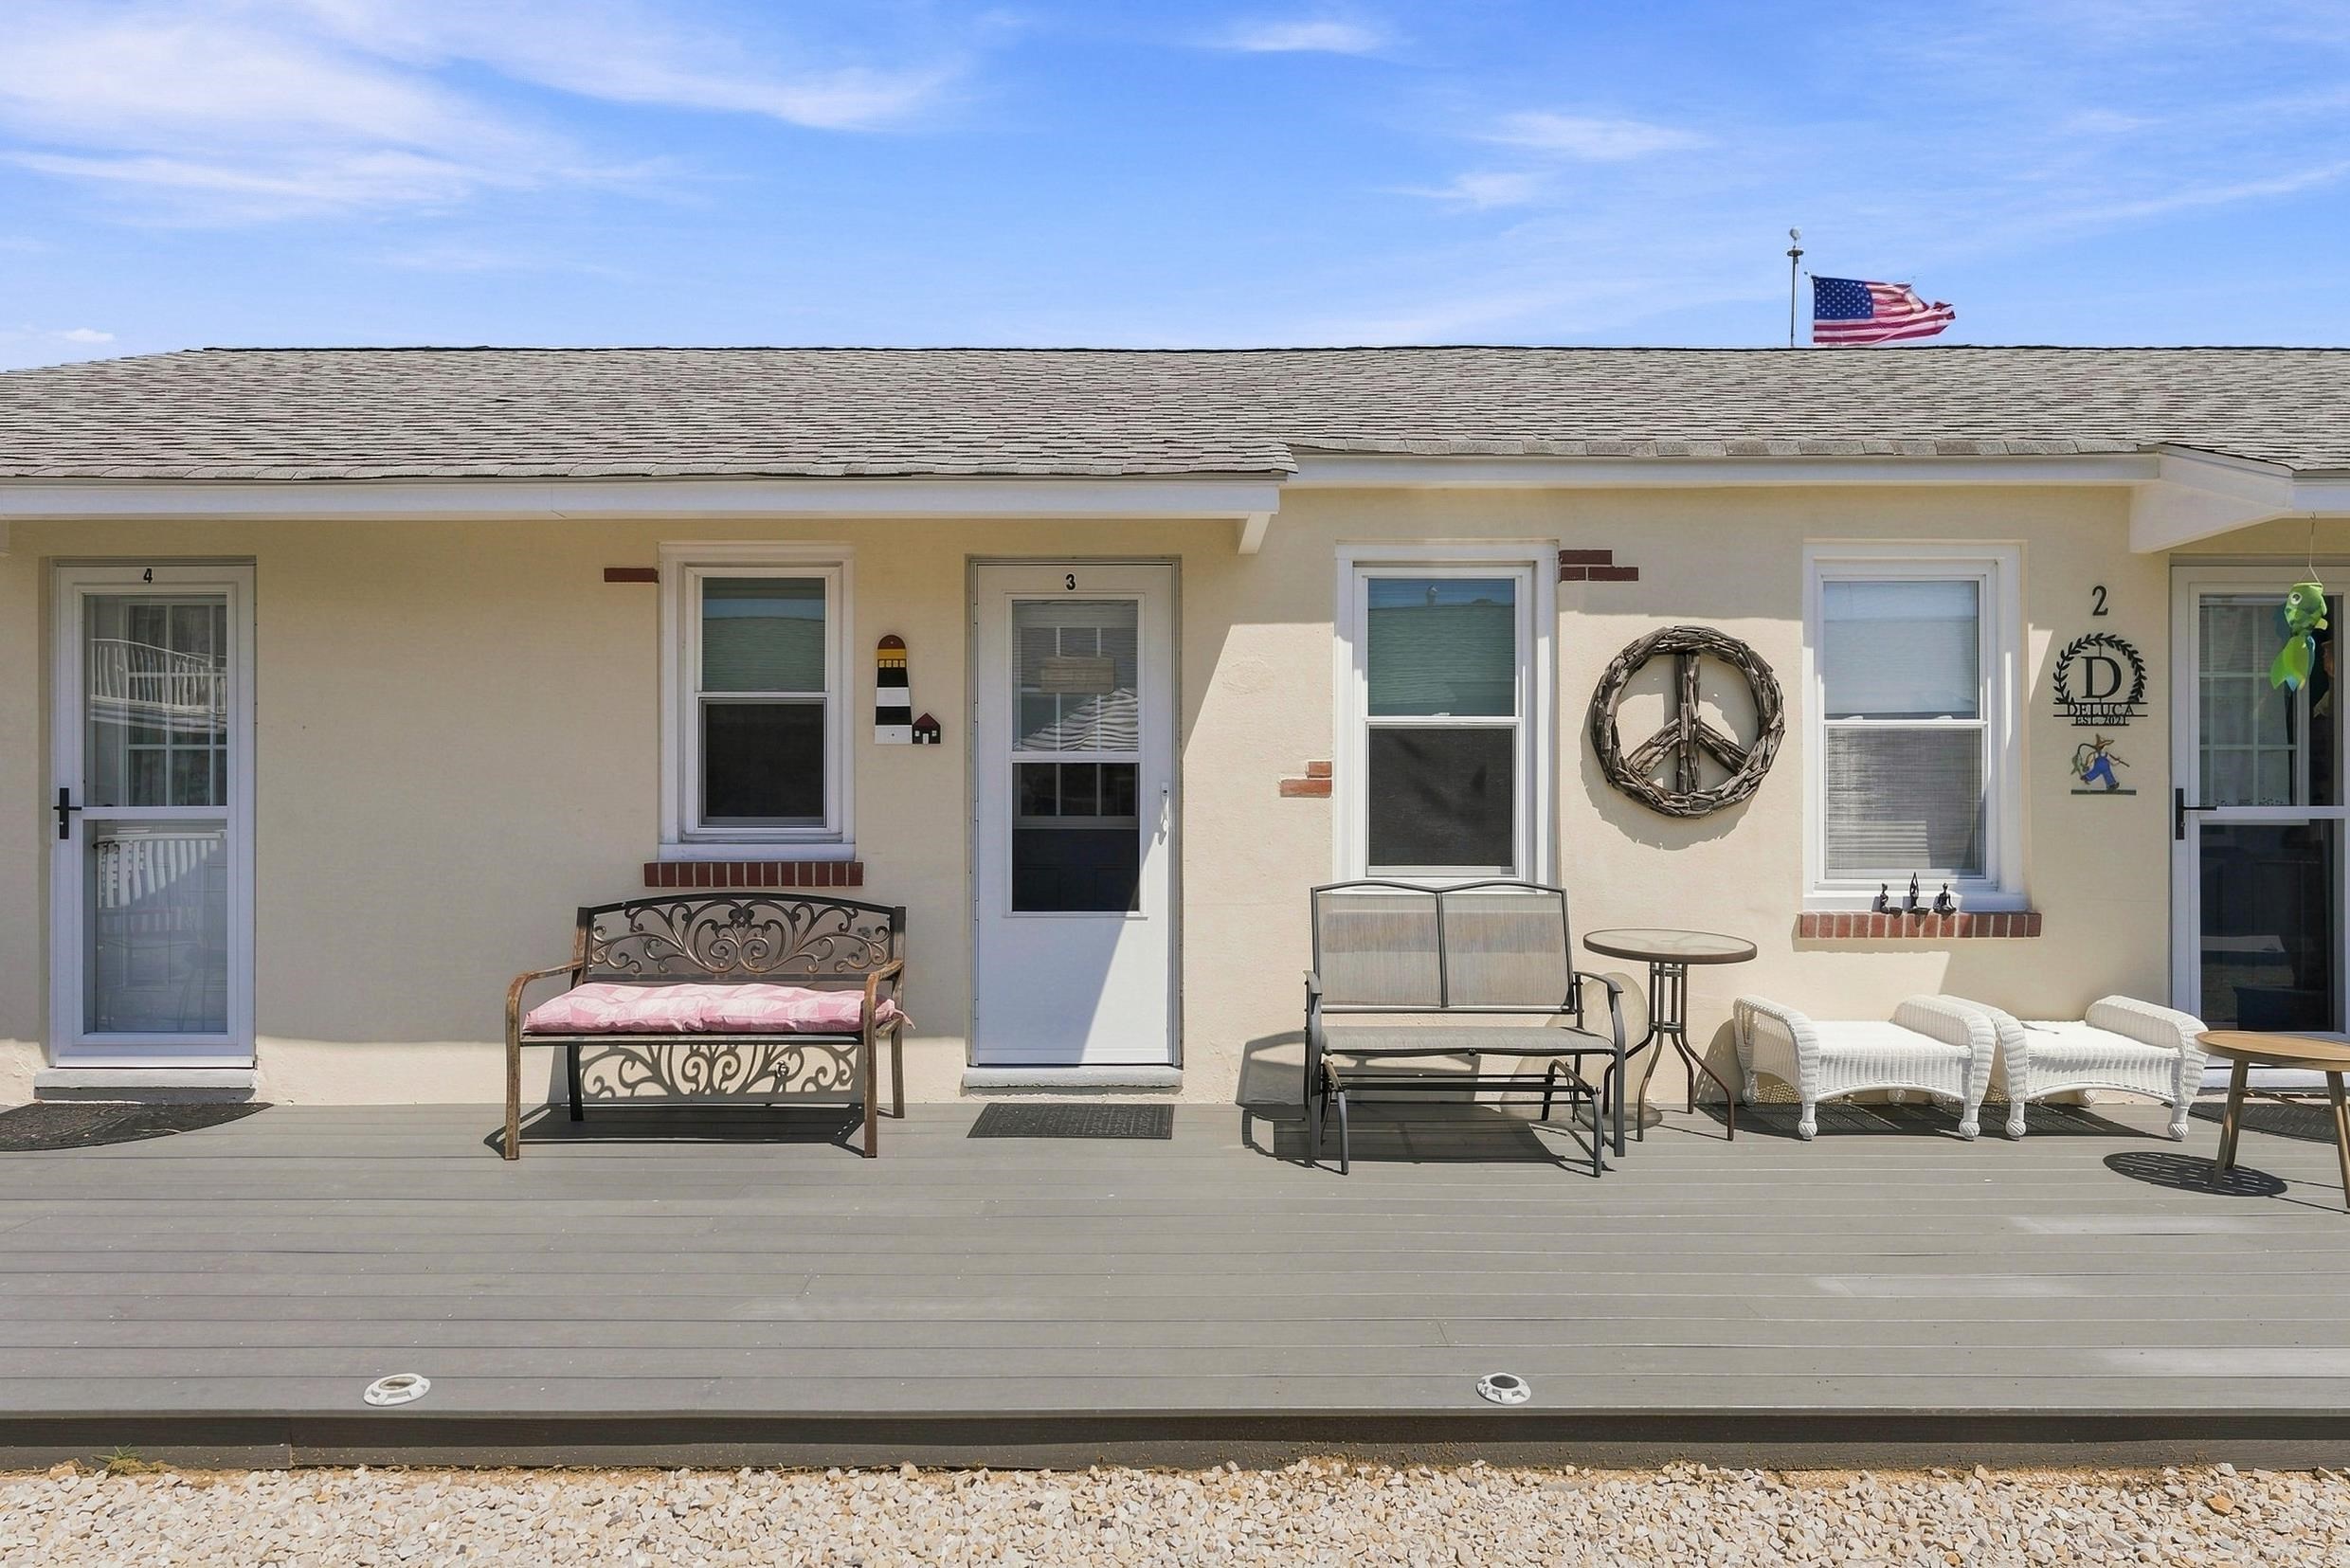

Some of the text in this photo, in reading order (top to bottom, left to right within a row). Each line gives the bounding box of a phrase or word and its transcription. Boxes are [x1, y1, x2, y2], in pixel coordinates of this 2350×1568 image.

[143, 568, 153, 584] 4
[1065, 573, 1076, 591] 3
[2091, 585, 2108, 616] 2
[2081, 656, 2122, 699] D
[2067, 703, 2134, 716] DELUCA
